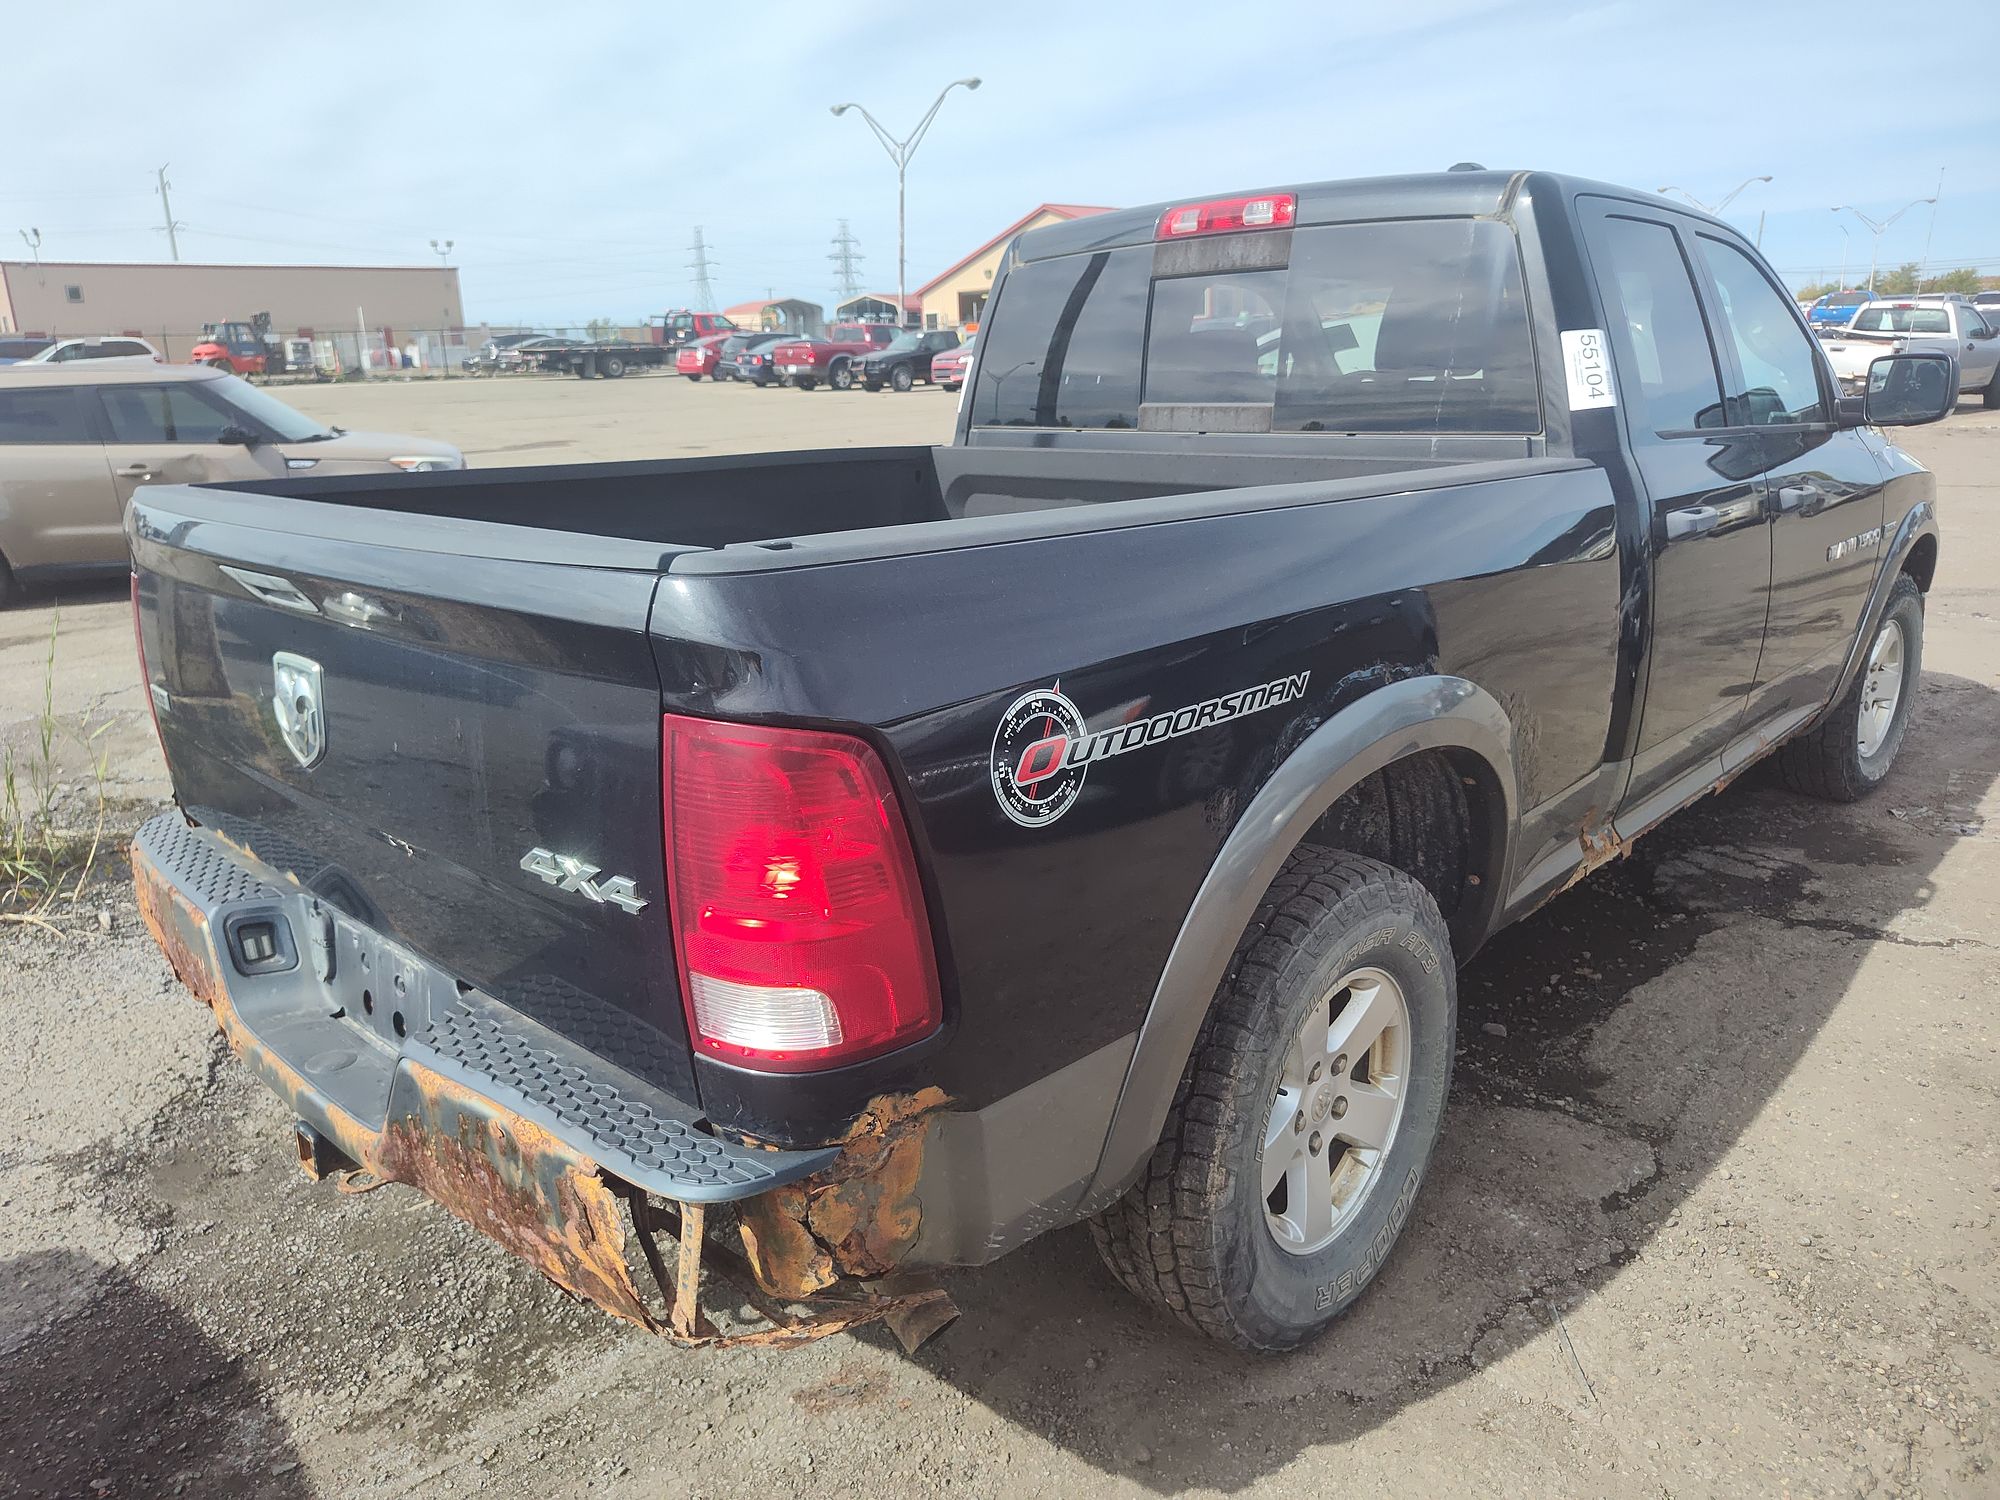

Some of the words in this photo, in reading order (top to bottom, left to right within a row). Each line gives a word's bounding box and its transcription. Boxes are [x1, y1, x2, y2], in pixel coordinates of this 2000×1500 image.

[1580, 334, 1605, 400] 55104
[1014, 670, 1311, 787] OUTDOORSMAN
[1031, 700, 1043, 709] N
[1399, 930, 1440, 975] AT3
[1314, 1167, 1420, 1311] COOPER
